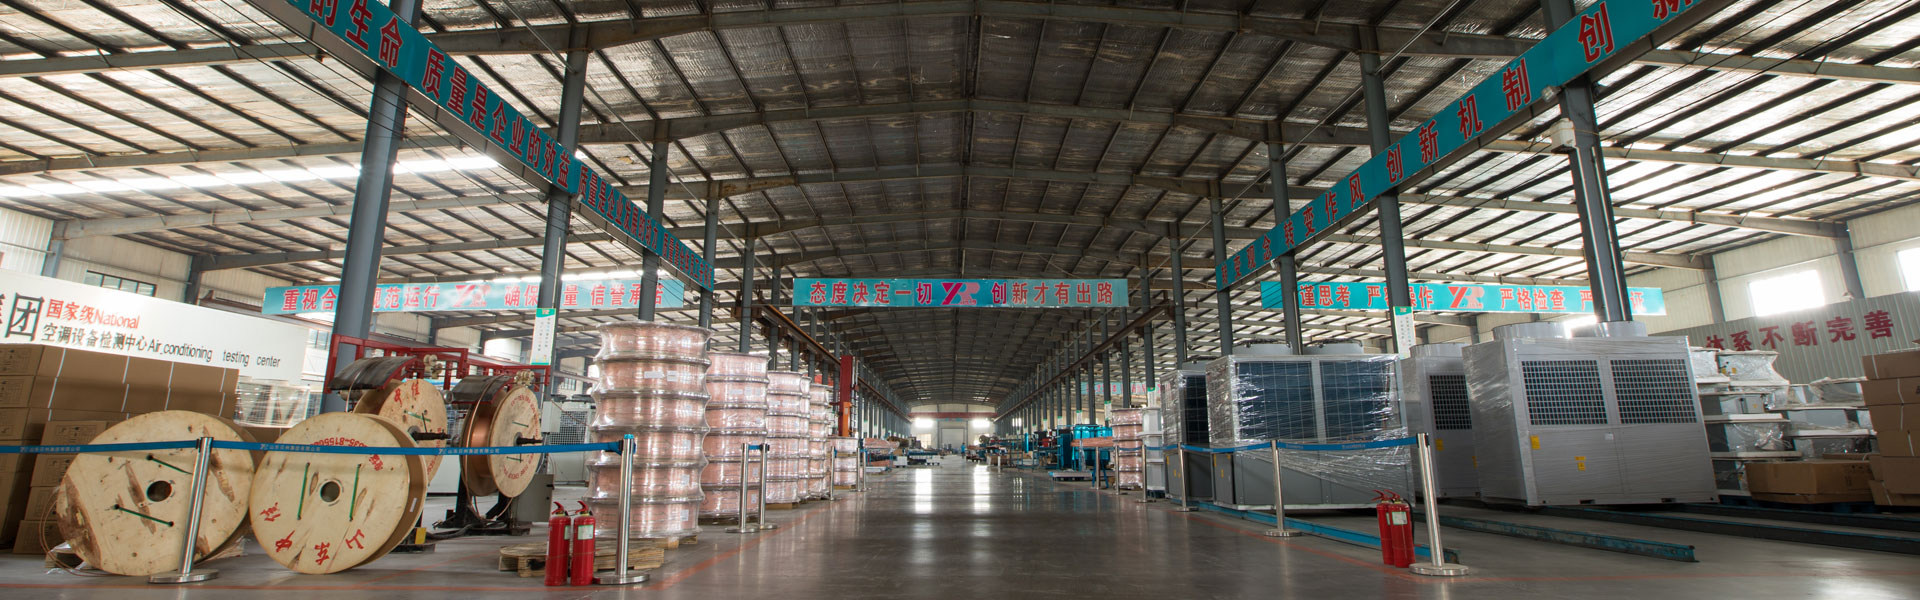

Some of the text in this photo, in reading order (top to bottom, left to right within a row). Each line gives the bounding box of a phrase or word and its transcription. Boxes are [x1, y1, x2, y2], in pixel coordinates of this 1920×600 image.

[422, 47, 570, 188] 质量是企业的效益
[1221, 236, 1272, 284] 转变观念
[1283, 172, 1365, 249] 转变作风
[1385, 57, 1532, 184] 创新机制
[281, 288, 338, 312] 重视合
[504, 284, 579, 307] 确保量
[809, 281, 933, 306] 态度决定一切
[991, 281, 1115, 306] 创新才有出路
[1299, 284, 1351, 308] 谨思考
[1499, 287, 1566, 311] 严格检查
[1579, 289, 1647, 312] 严证
[0, 292, 46, 342] 团
[222, 348, 250, 367] testing
[256, 354, 282, 369] center
